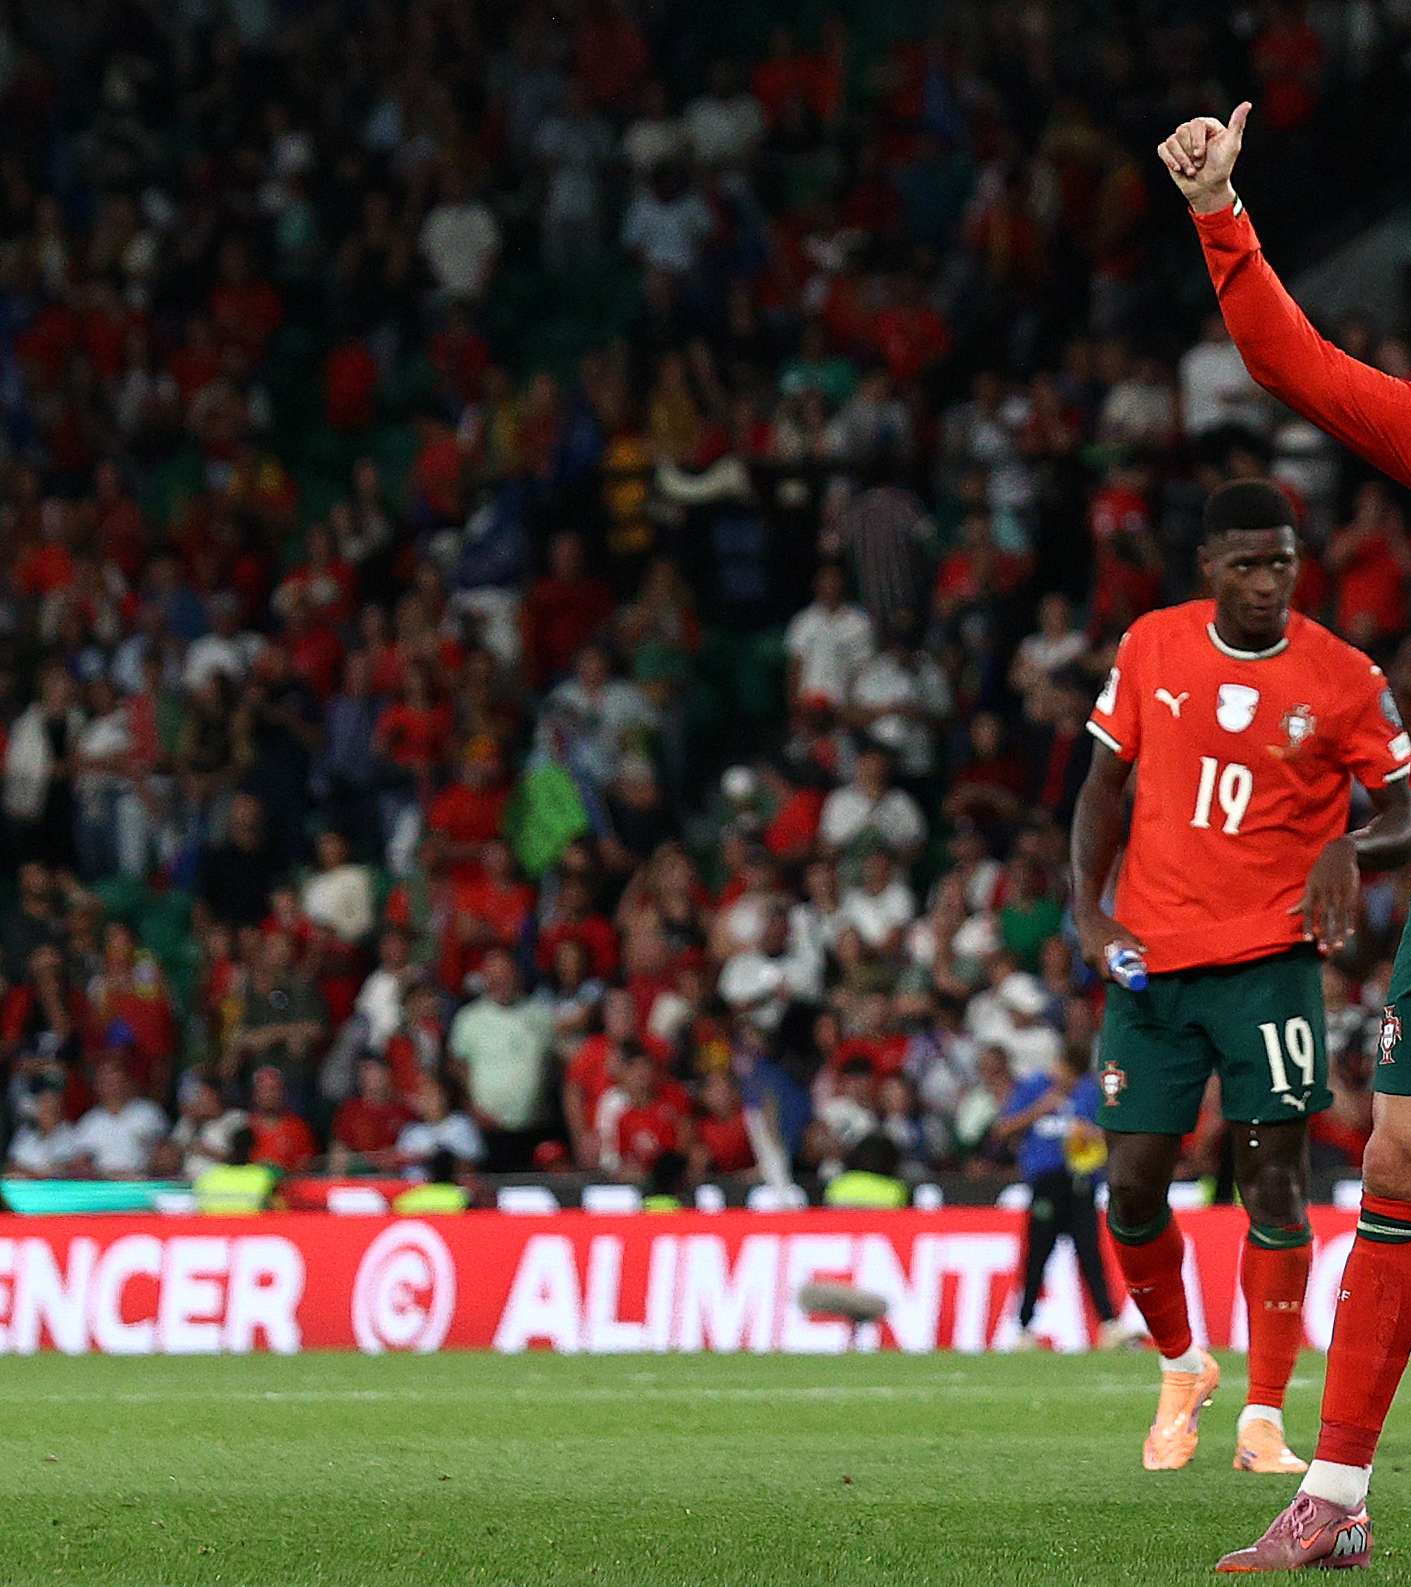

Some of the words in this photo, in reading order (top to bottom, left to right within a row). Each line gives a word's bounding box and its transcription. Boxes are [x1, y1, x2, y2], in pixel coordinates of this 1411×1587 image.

[1189, 756, 1254, 835] 19
[1257, 1016, 1315, 1093] 19
[0, 1233, 306, 1354] NCER
